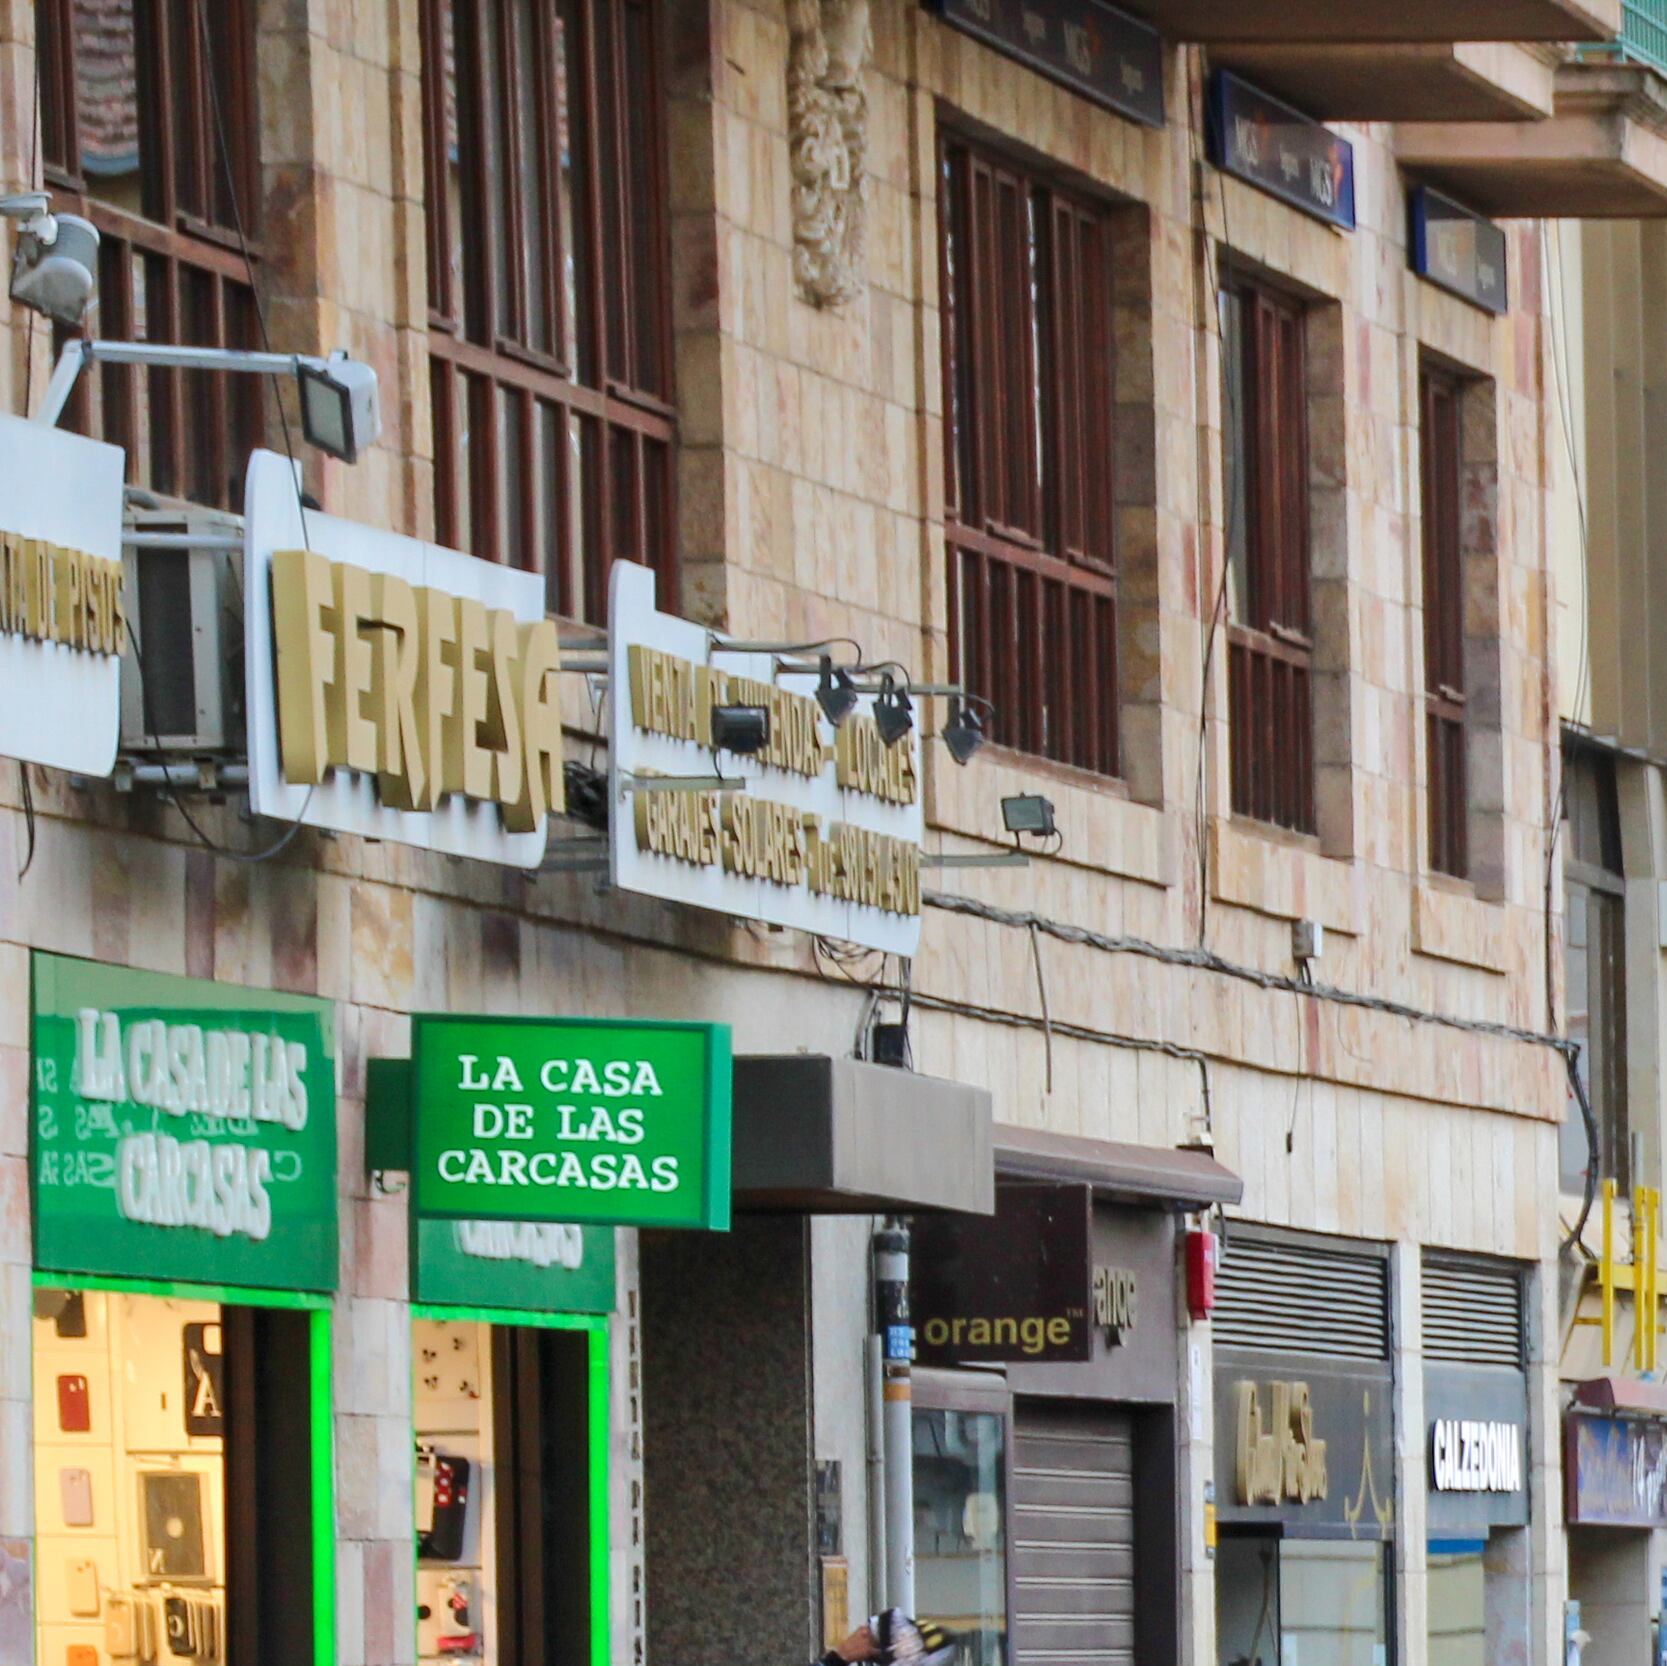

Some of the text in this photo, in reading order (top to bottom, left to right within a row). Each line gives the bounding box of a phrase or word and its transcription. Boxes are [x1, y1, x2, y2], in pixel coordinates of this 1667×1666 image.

[55, 546, 127, 658] PISOS
[272, 550, 565, 833] FERFESA
[628, 644, 698, 742] VENTA
[720, 793, 803, 887] SOLARES
[74, 1007, 128, 1102] LA
[127, 1018, 208, 1117] CASA
[250, 1031, 308, 1131] LAS
[457, 1054, 663, 1097] LA CASA
[437, 1149, 679, 1192] CARCASAS
[473, 1103, 645, 1144] DE LAS
[116, 1133, 272, 1240] CARCASAS
[1092, 1265, 1138, 1351] ange
[1433, 1418, 1522, 1492] CALZEDONIA
